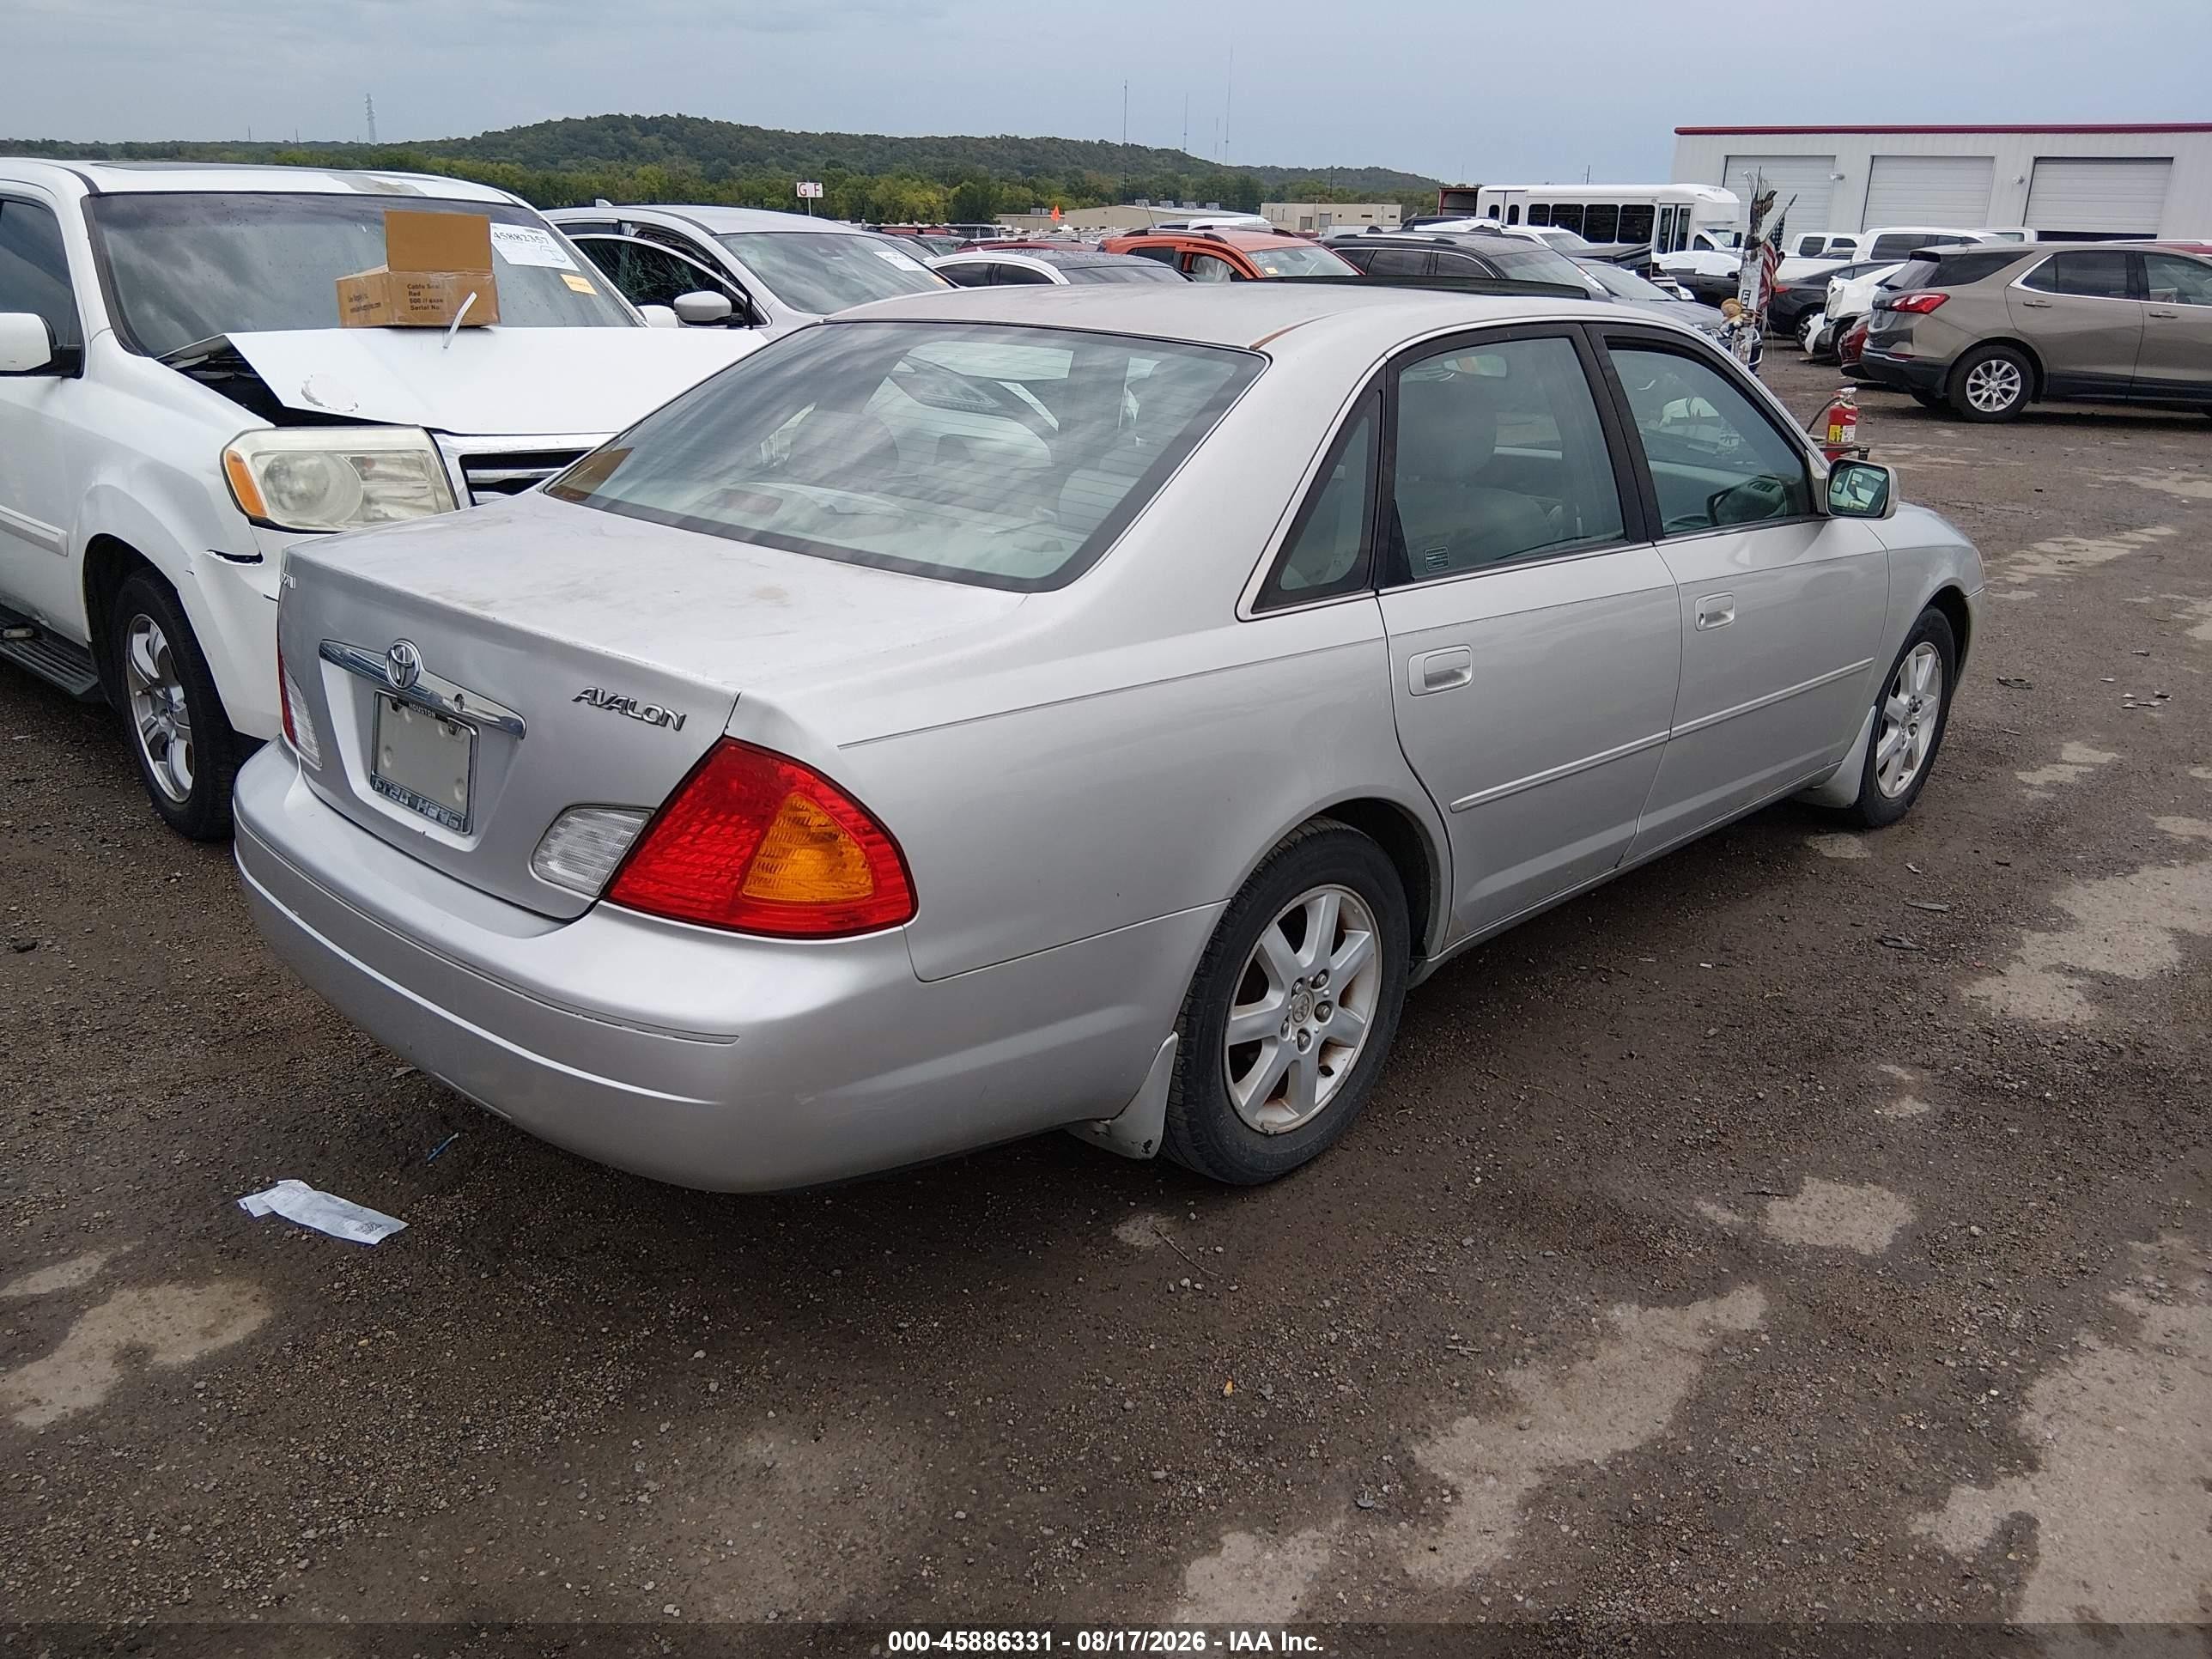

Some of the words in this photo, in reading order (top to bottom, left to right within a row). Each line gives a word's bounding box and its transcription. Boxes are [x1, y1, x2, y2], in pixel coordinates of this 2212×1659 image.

[798, 183, 808, 197] G
[408, 702, 436, 719] HOUSTON
[571, 686, 688, 732] AVALON
